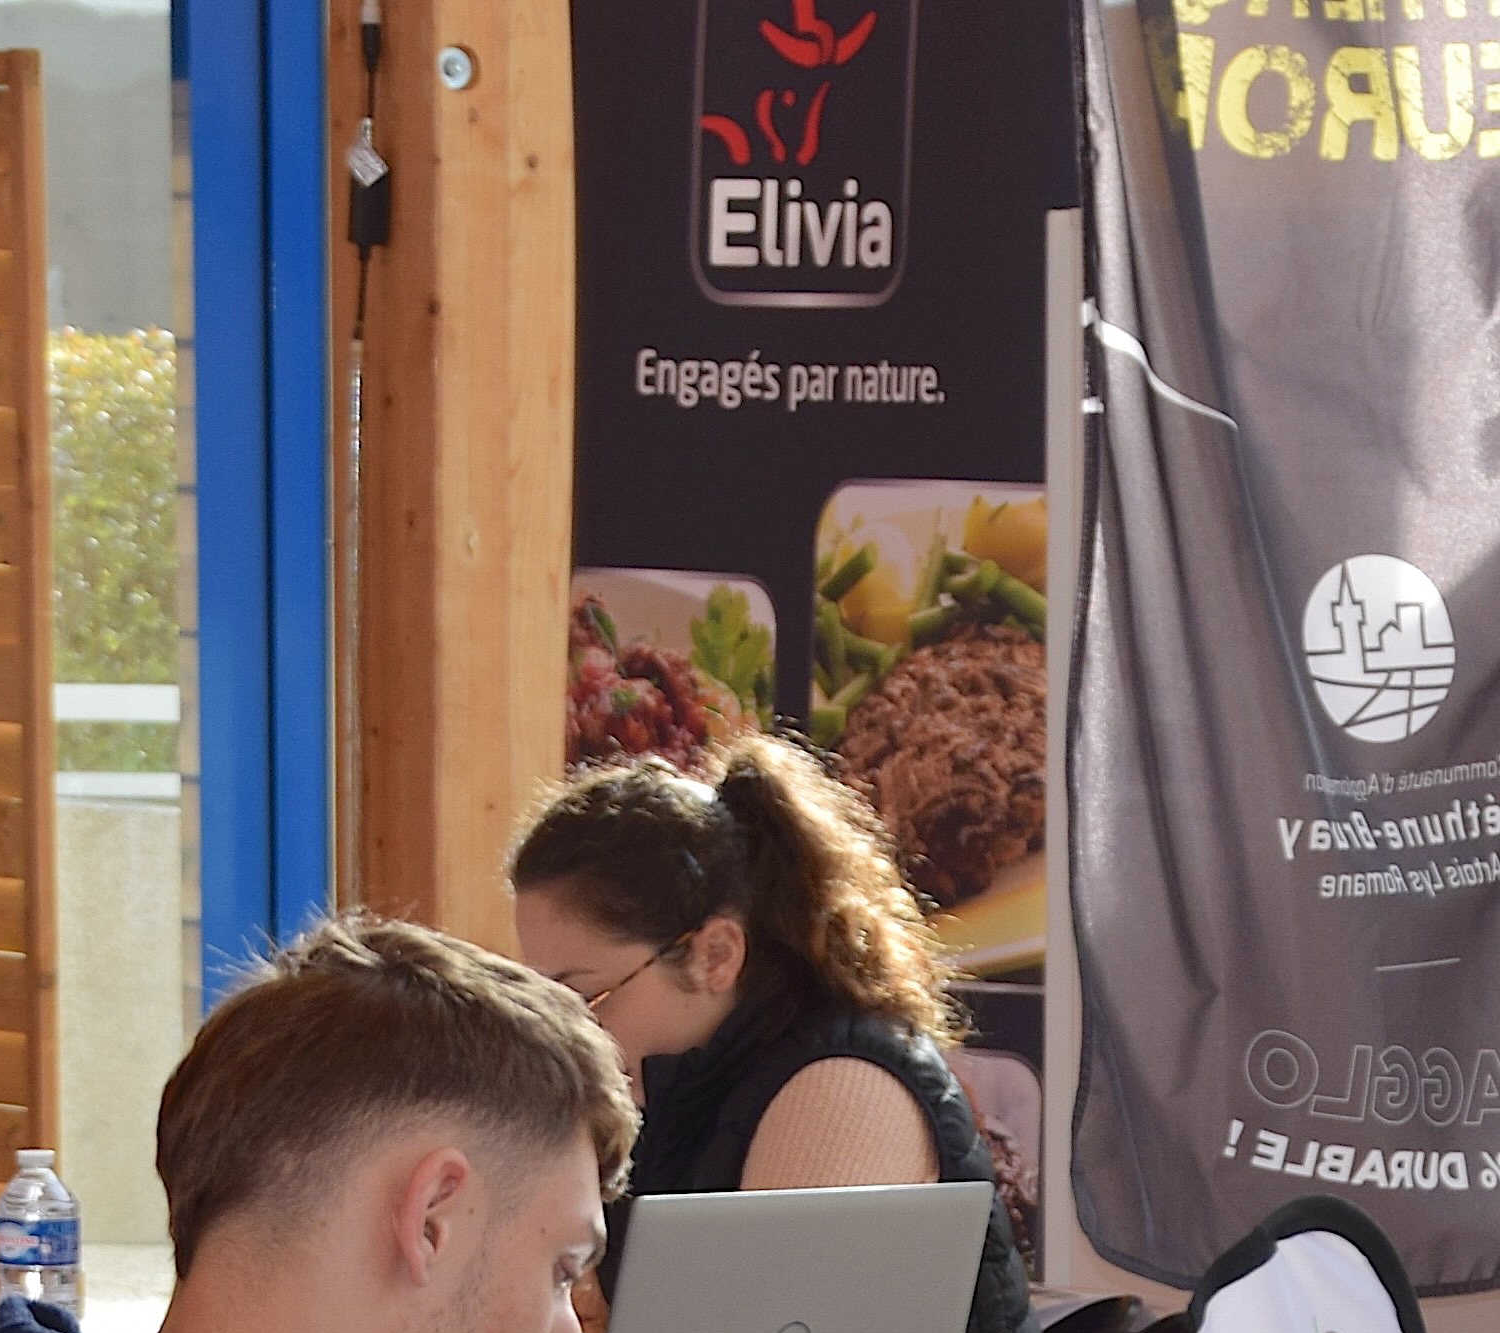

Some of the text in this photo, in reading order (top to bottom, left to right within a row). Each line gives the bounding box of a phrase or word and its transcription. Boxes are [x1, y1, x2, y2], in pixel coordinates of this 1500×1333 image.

[708, 177, 894, 268] Elivia
[635, 348, 946, 412] Engagés par nature.
